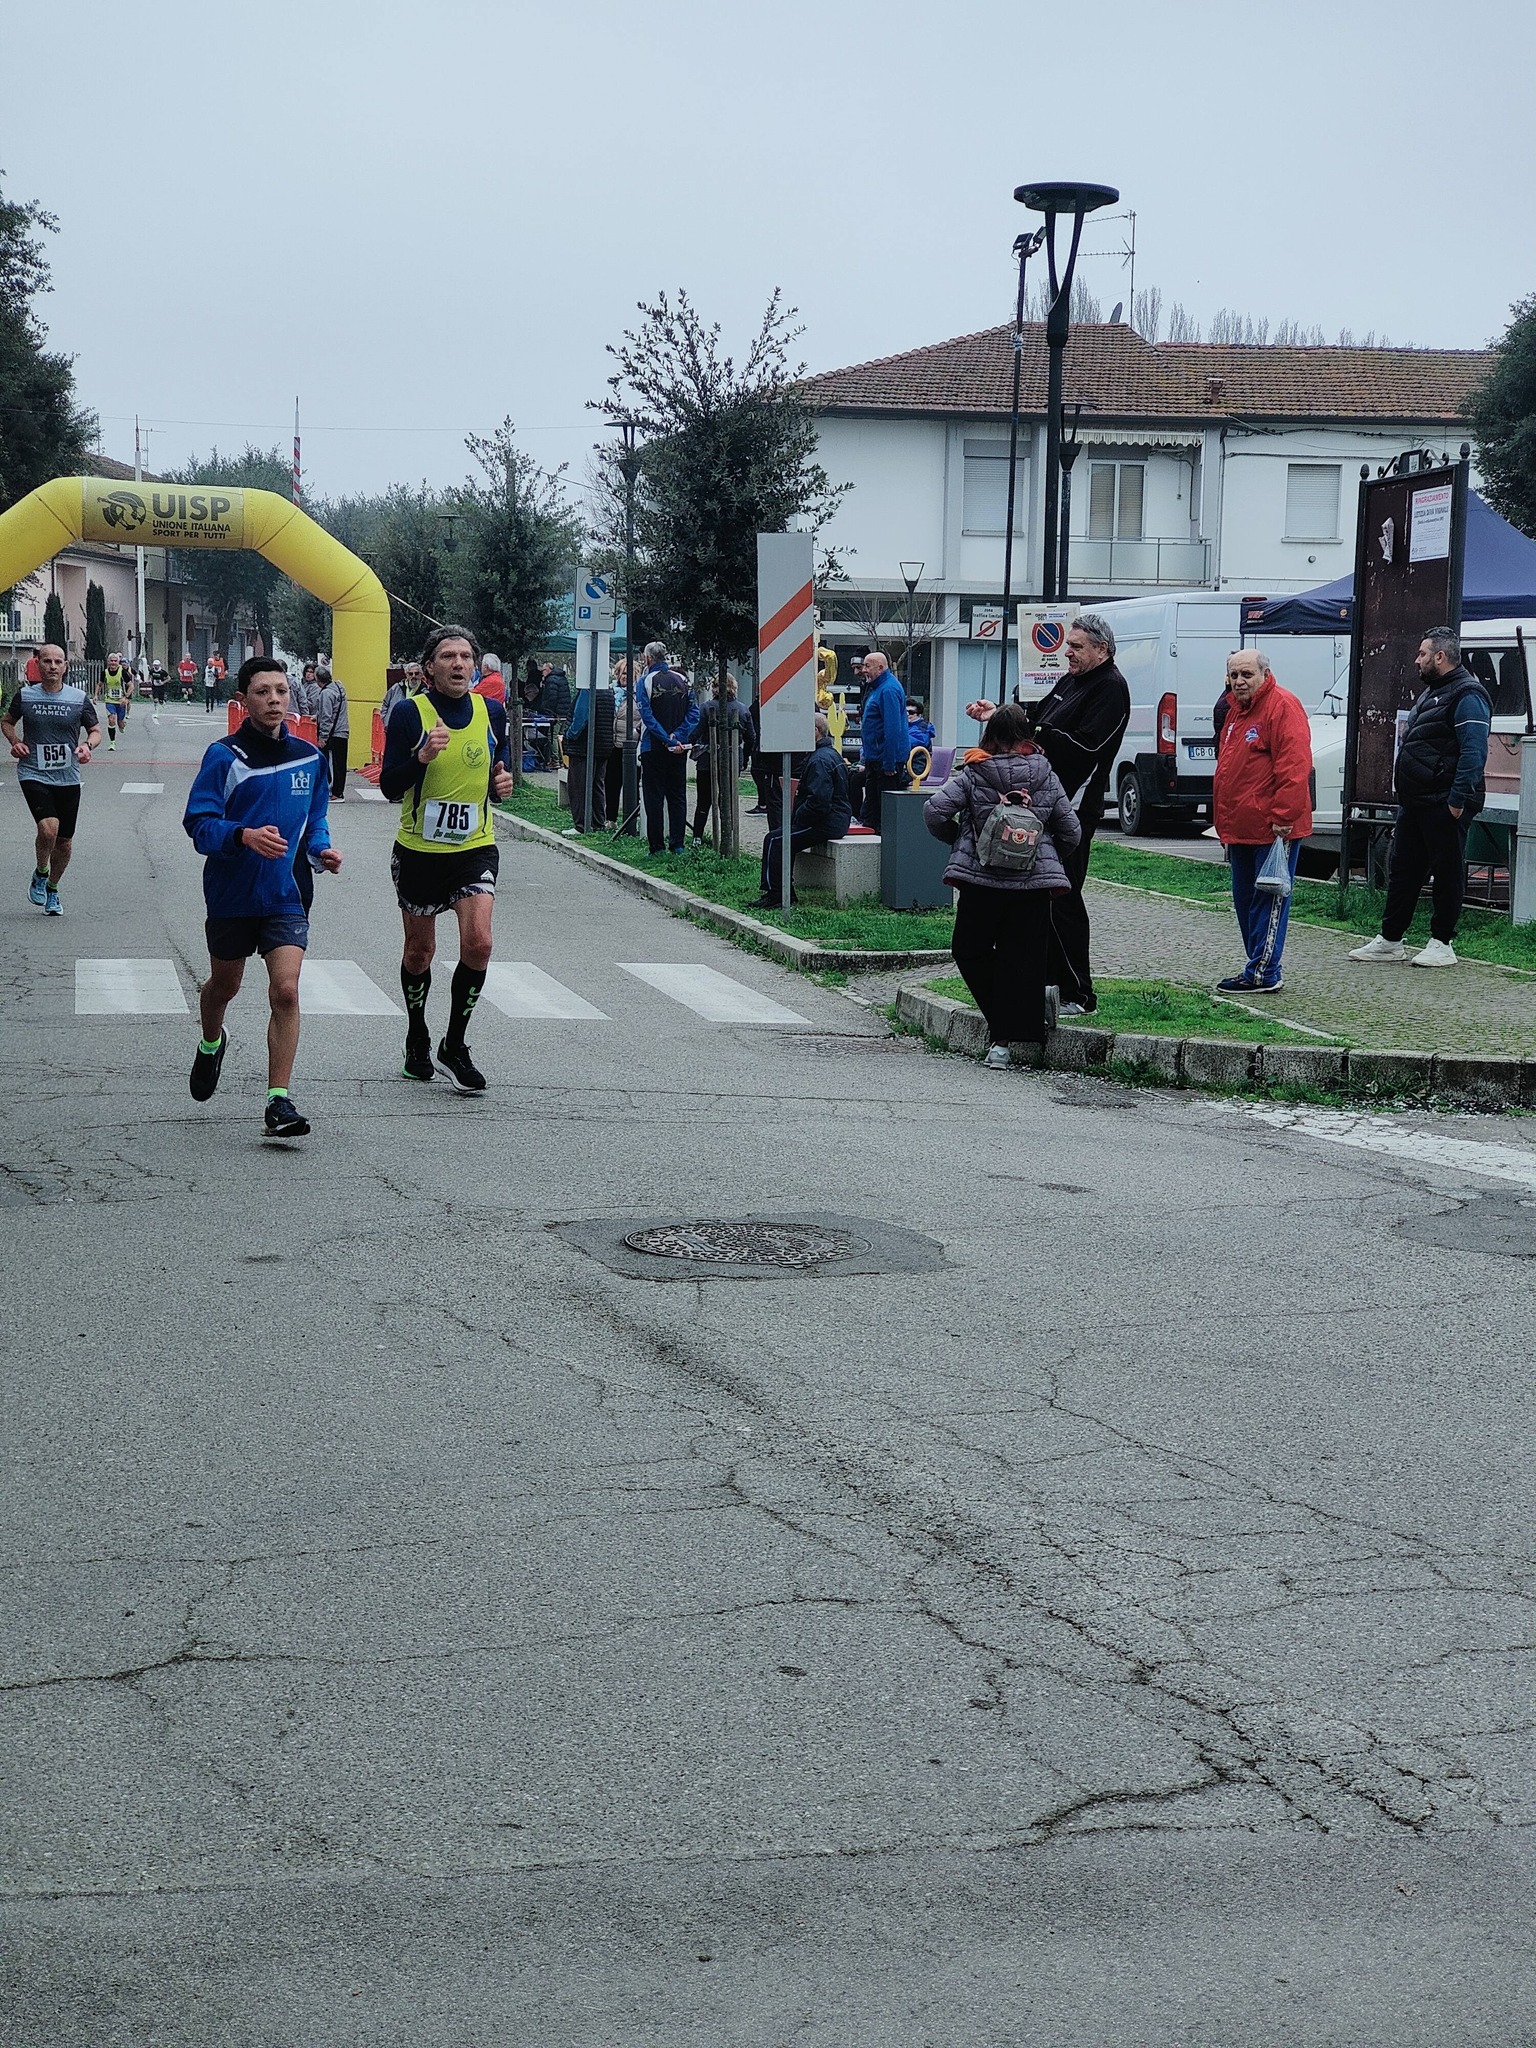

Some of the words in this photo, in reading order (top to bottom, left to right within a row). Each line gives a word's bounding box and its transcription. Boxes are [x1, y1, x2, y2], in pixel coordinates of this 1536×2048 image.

[152, 493, 231, 521] UISP
[152, 520, 187, 529] UNIONE
[191, 522, 231, 532] ITALIANA
[152, 529, 180, 538] SPORT
[580, 607, 589, 618] P
[43, 745, 67, 761] 654
[290, 773, 311, 789] Icel
[436, 802, 470, 831] 785
